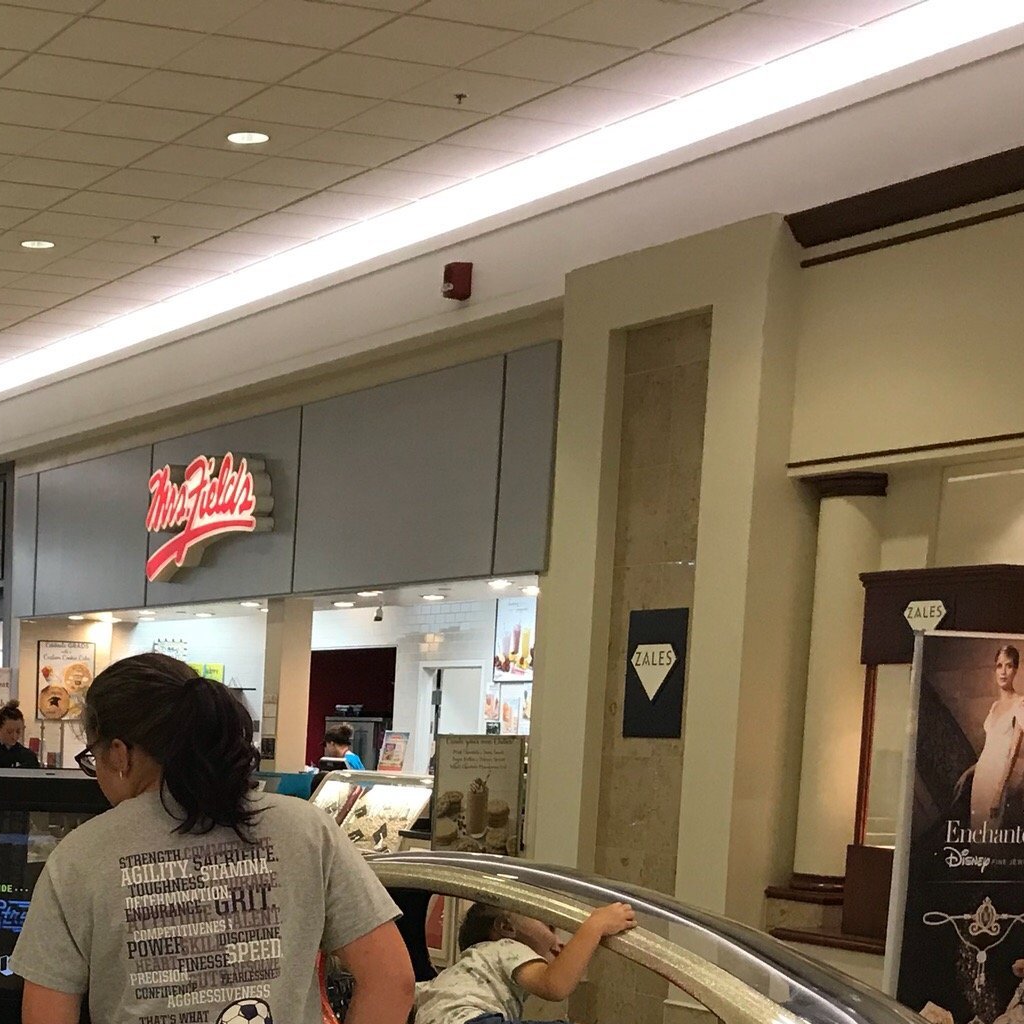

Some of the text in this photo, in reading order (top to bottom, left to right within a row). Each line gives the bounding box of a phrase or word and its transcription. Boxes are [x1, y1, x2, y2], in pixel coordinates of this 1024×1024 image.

[907, 605, 942, 619] ZALES
[635, 650, 672, 667] ZALES
[943, 846, 991, 873] Disney
[121, 858, 273, 887] AGILITY. STAMINA.
[128, 874, 209, 898] TOUGHNESS.
[214, 882, 276, 916] GRIT.
[127, 936, 185, 959] POWER
[226, 938, 284, 963] SPEED.
[168, 984, 271, 1009] AGGRESSIVENESS
[179, 1011, 210, 1024] WHAT
